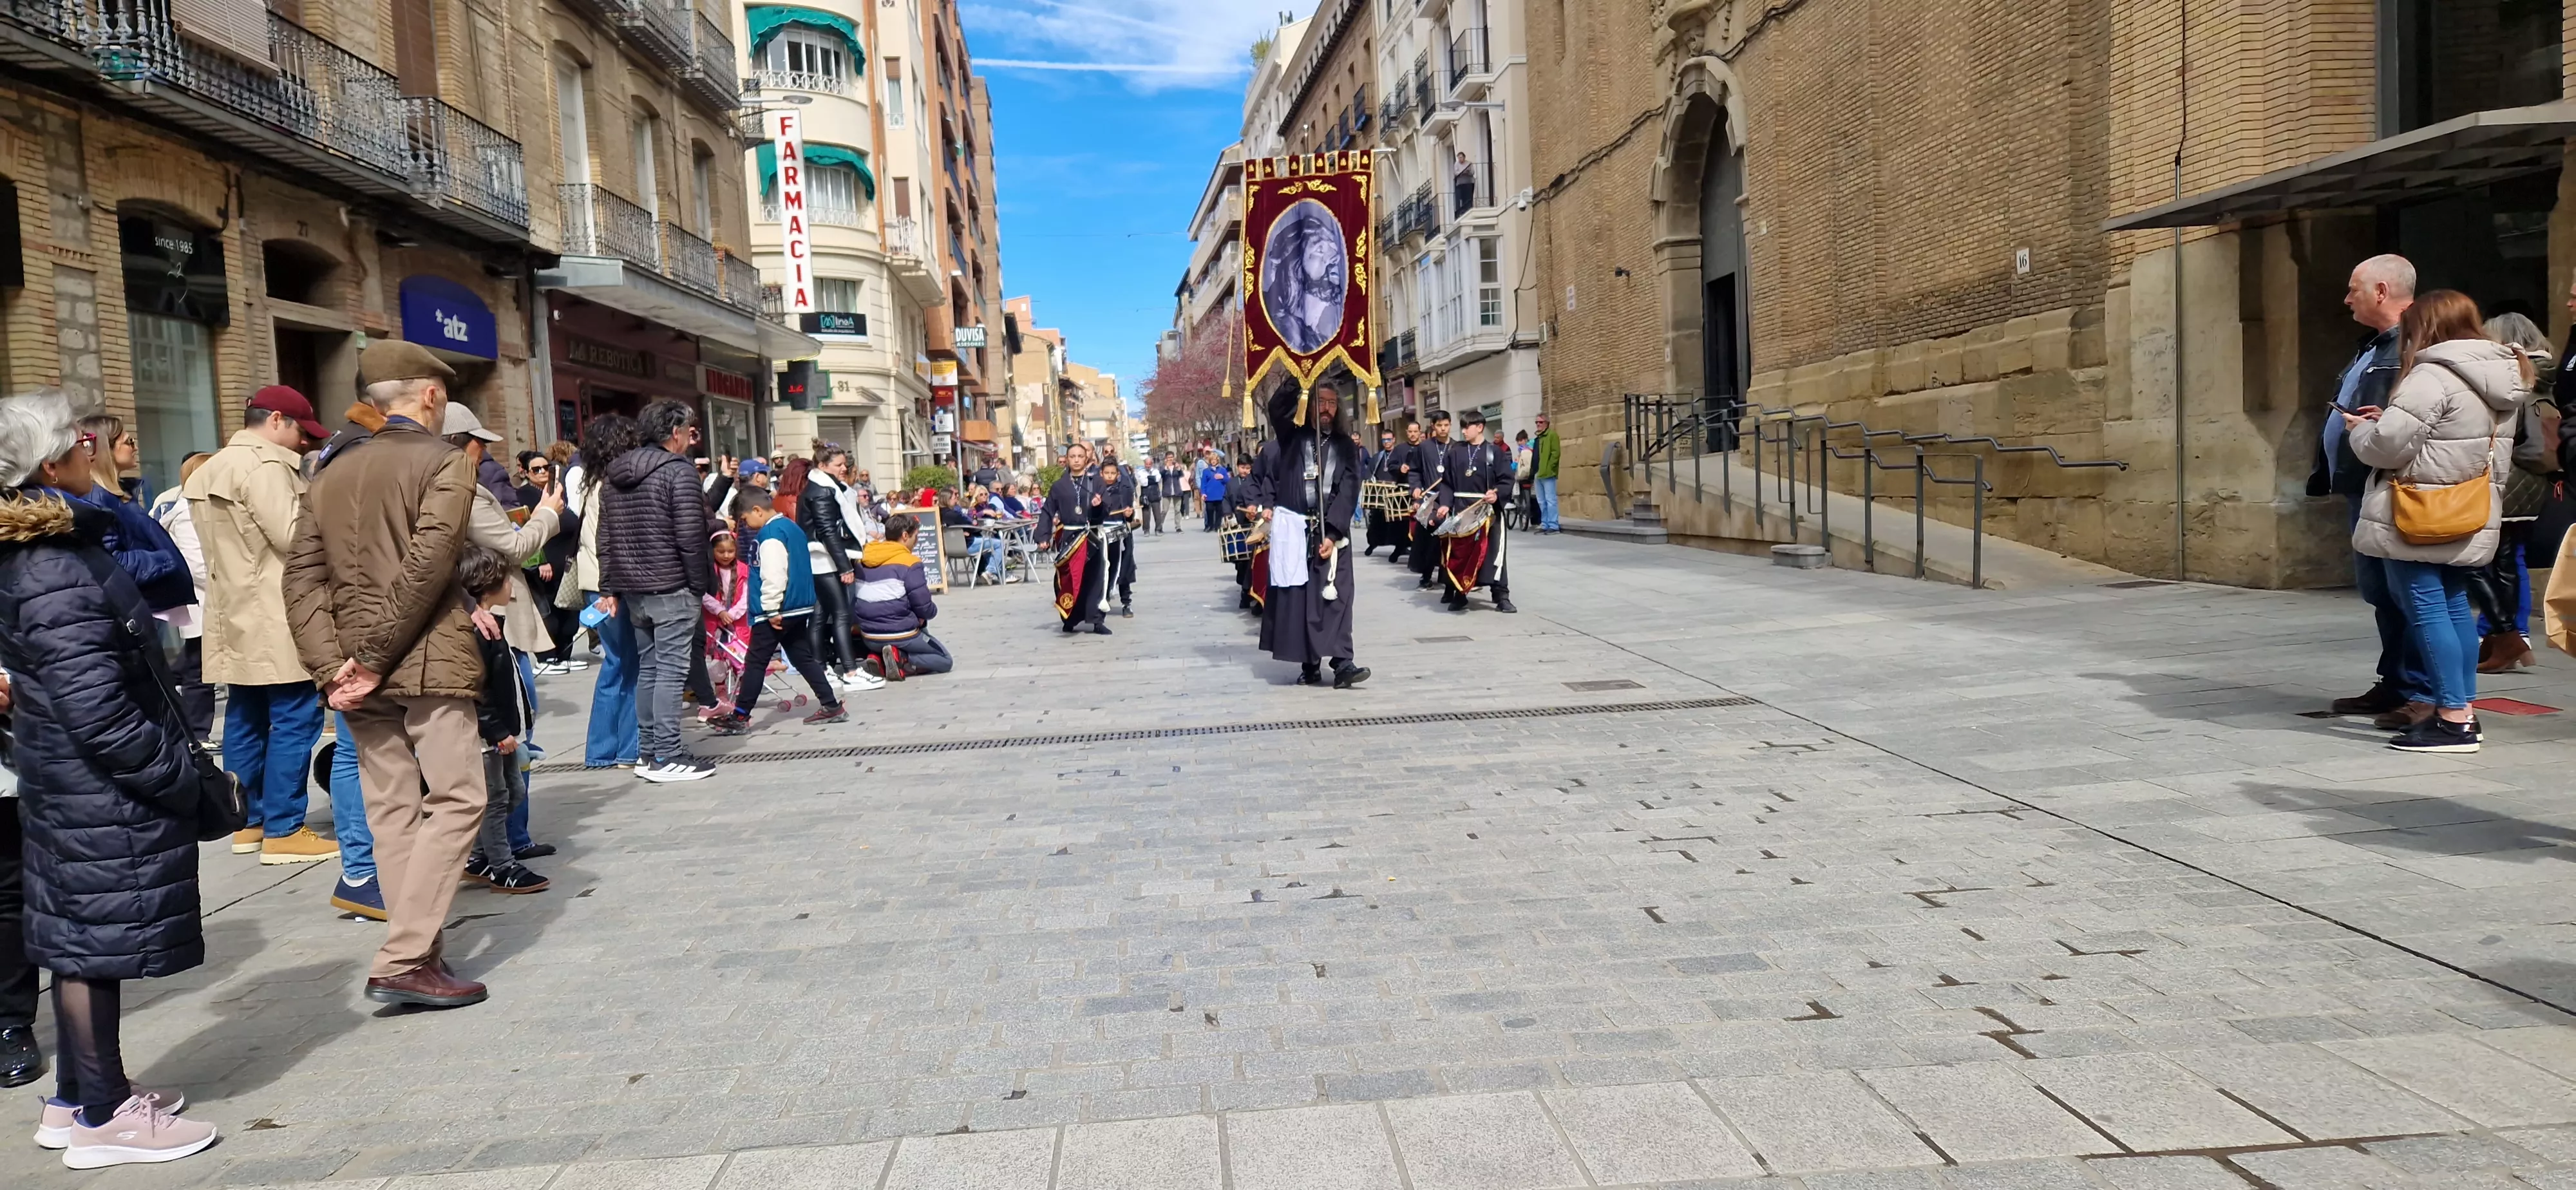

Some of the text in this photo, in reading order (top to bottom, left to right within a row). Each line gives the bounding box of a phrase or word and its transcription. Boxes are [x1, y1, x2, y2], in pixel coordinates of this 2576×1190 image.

[780, 117, 809, 307] FARMACIA
[155, 236, 193, 254] since 1985
[2019, 254, 2027, 269] 16
[443, 313, 468, 342] atz
[955, 327, 985, 342] DUVISA
[569, 340, 644, 374] LA REBOTICA
[838, 381, 850, 392] 81
